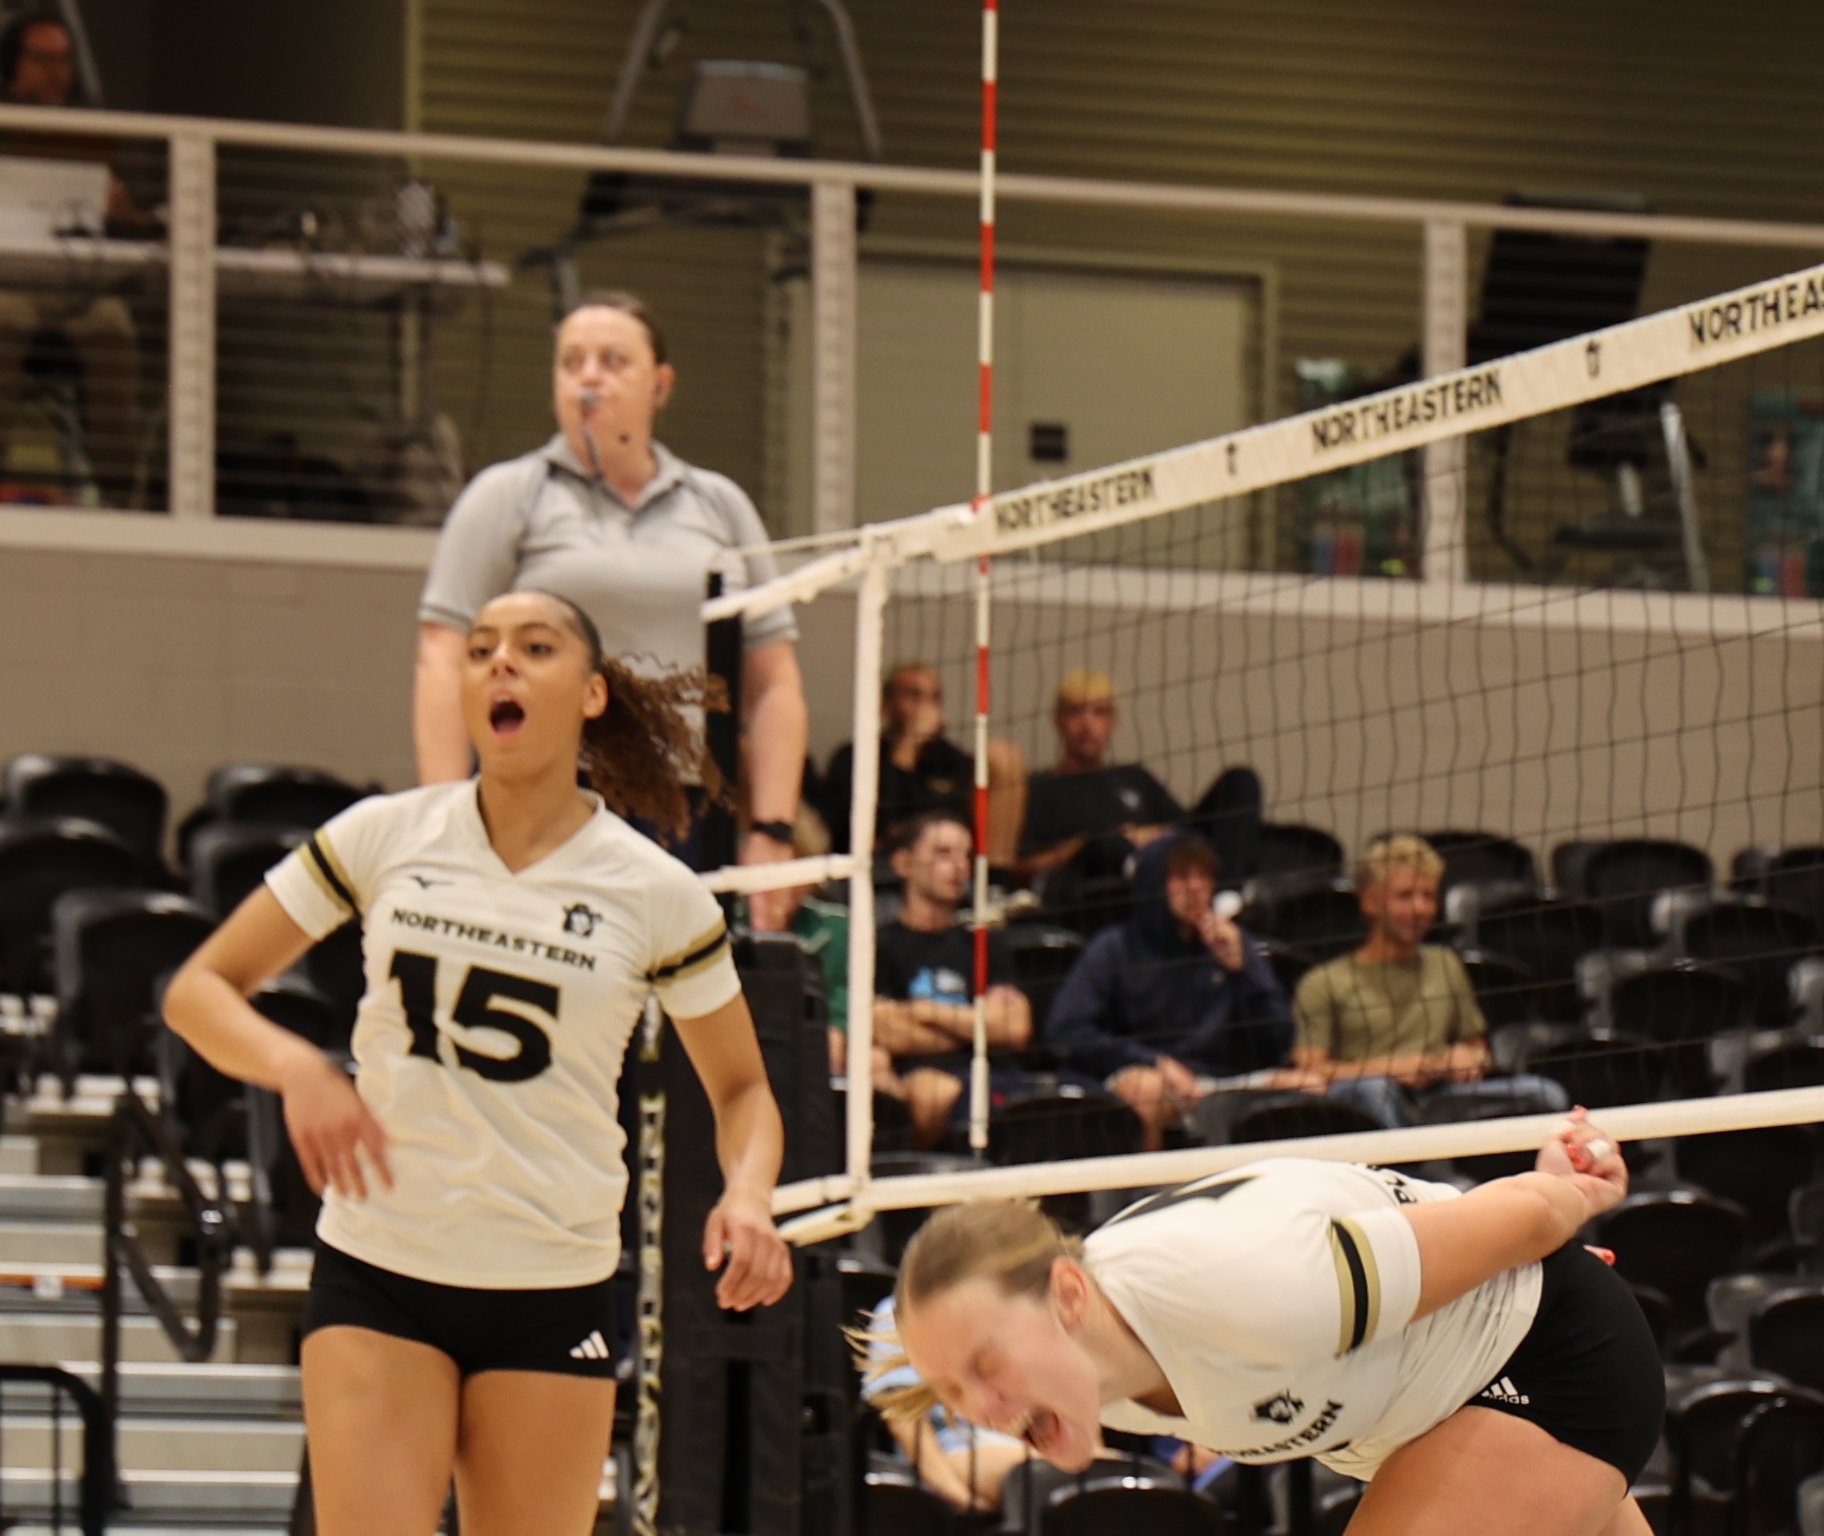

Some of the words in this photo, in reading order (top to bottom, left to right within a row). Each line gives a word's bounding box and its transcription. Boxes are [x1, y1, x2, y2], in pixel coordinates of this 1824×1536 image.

[1312, 369, 1503, 450] NORTHEASTERN
[391, 907, 597, 971] NORTHEASTERN
[388, 947, 561, 1083] 15
